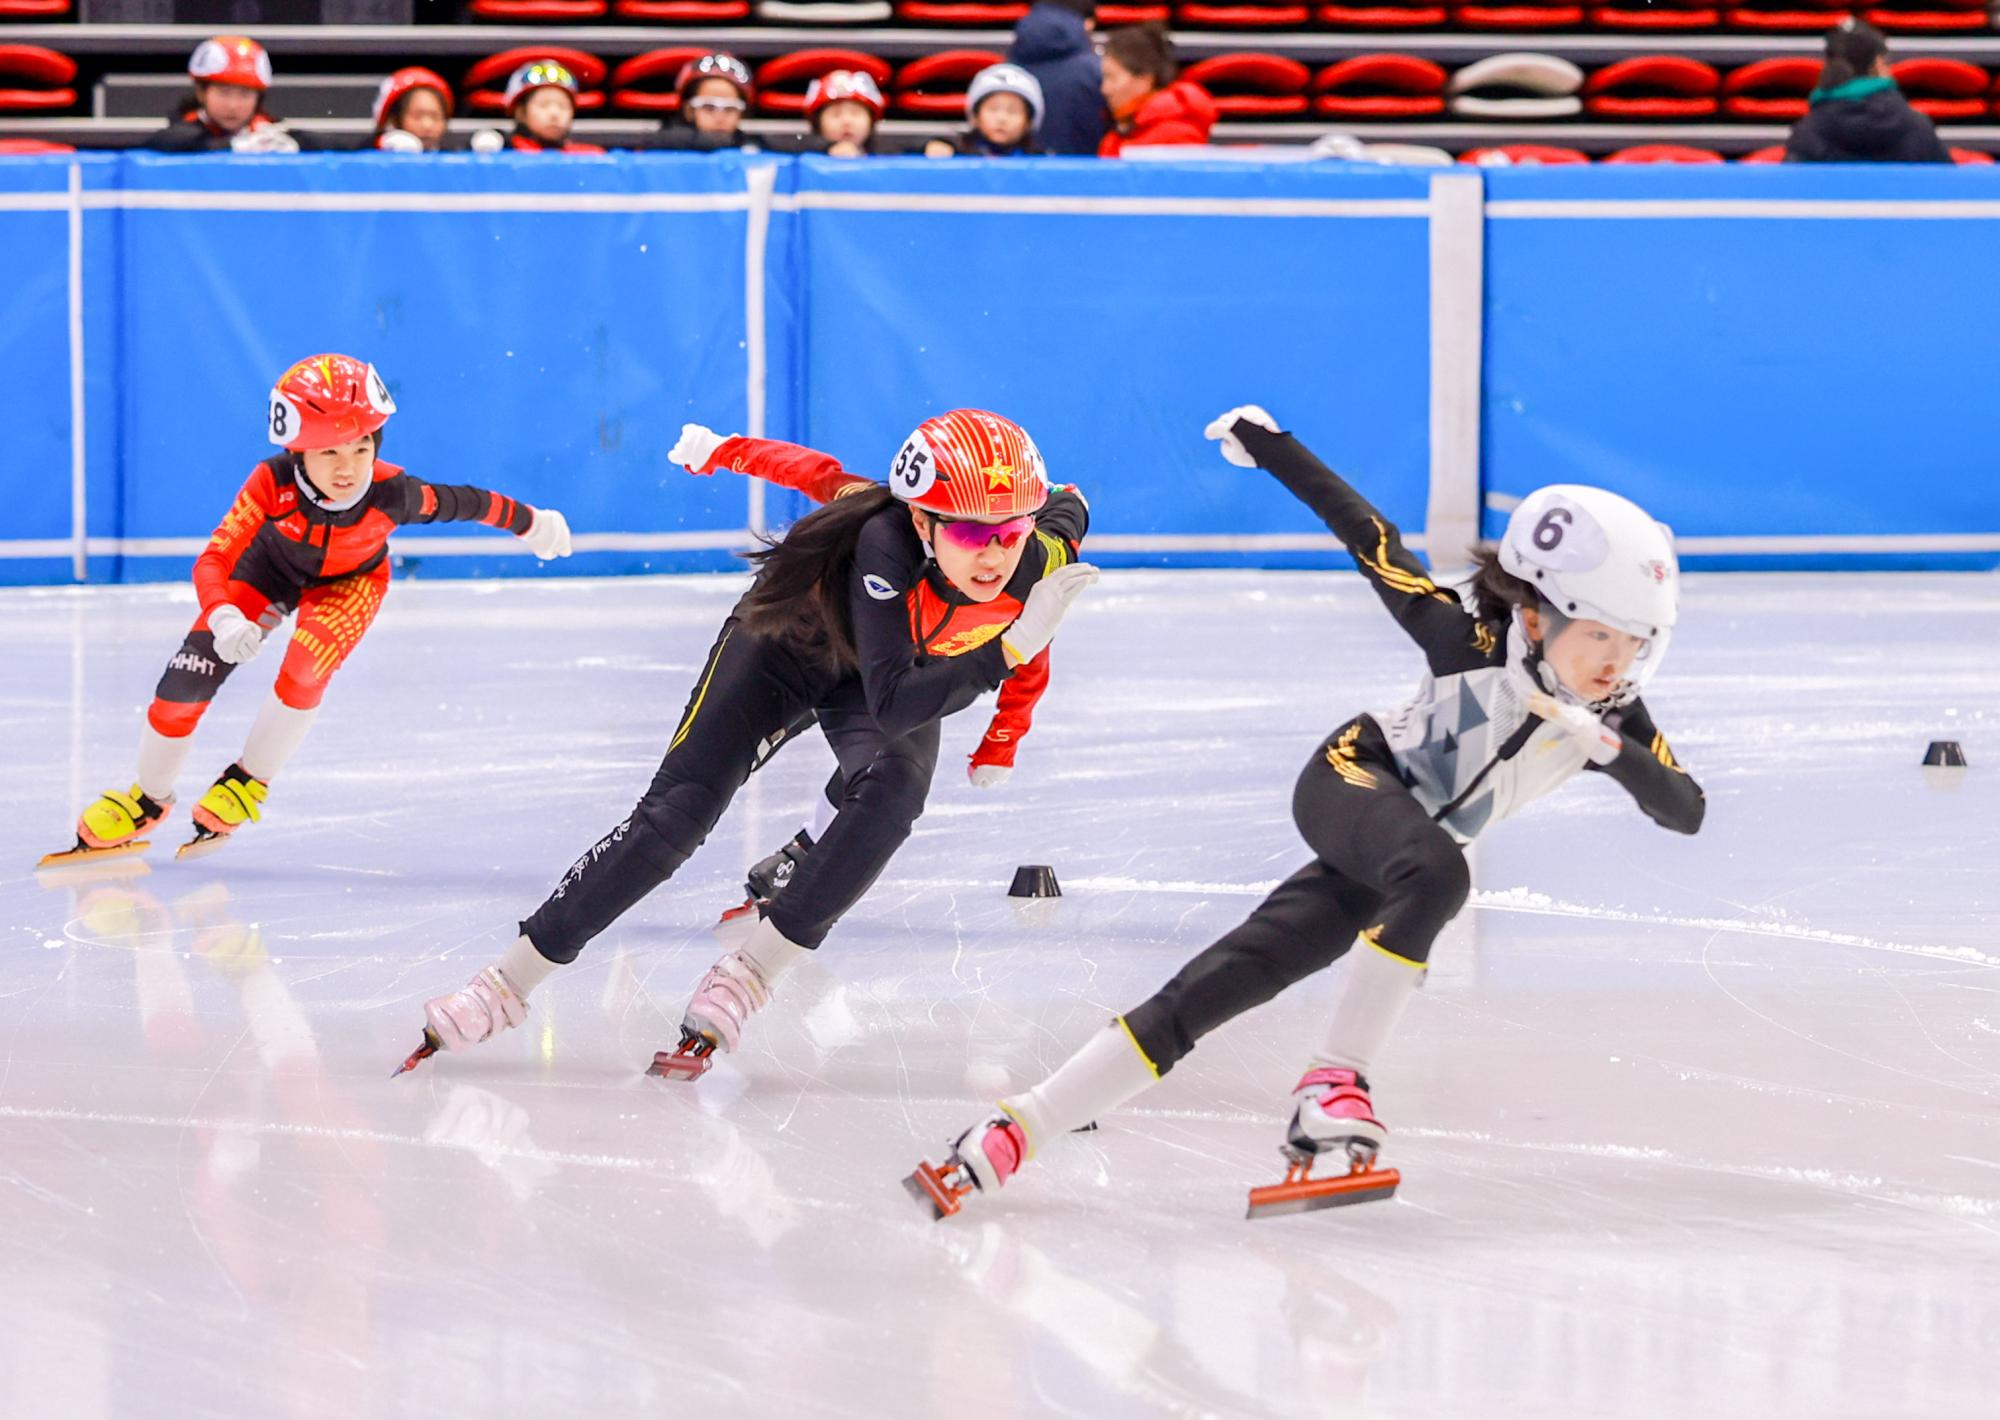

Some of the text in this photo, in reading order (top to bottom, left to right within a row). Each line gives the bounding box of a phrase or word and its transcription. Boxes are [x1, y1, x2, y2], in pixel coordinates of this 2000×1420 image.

[269, 401, 288, 436] 8
[895, 442, 928, 488] 55
[1533, 507, 1573, 552] 6
